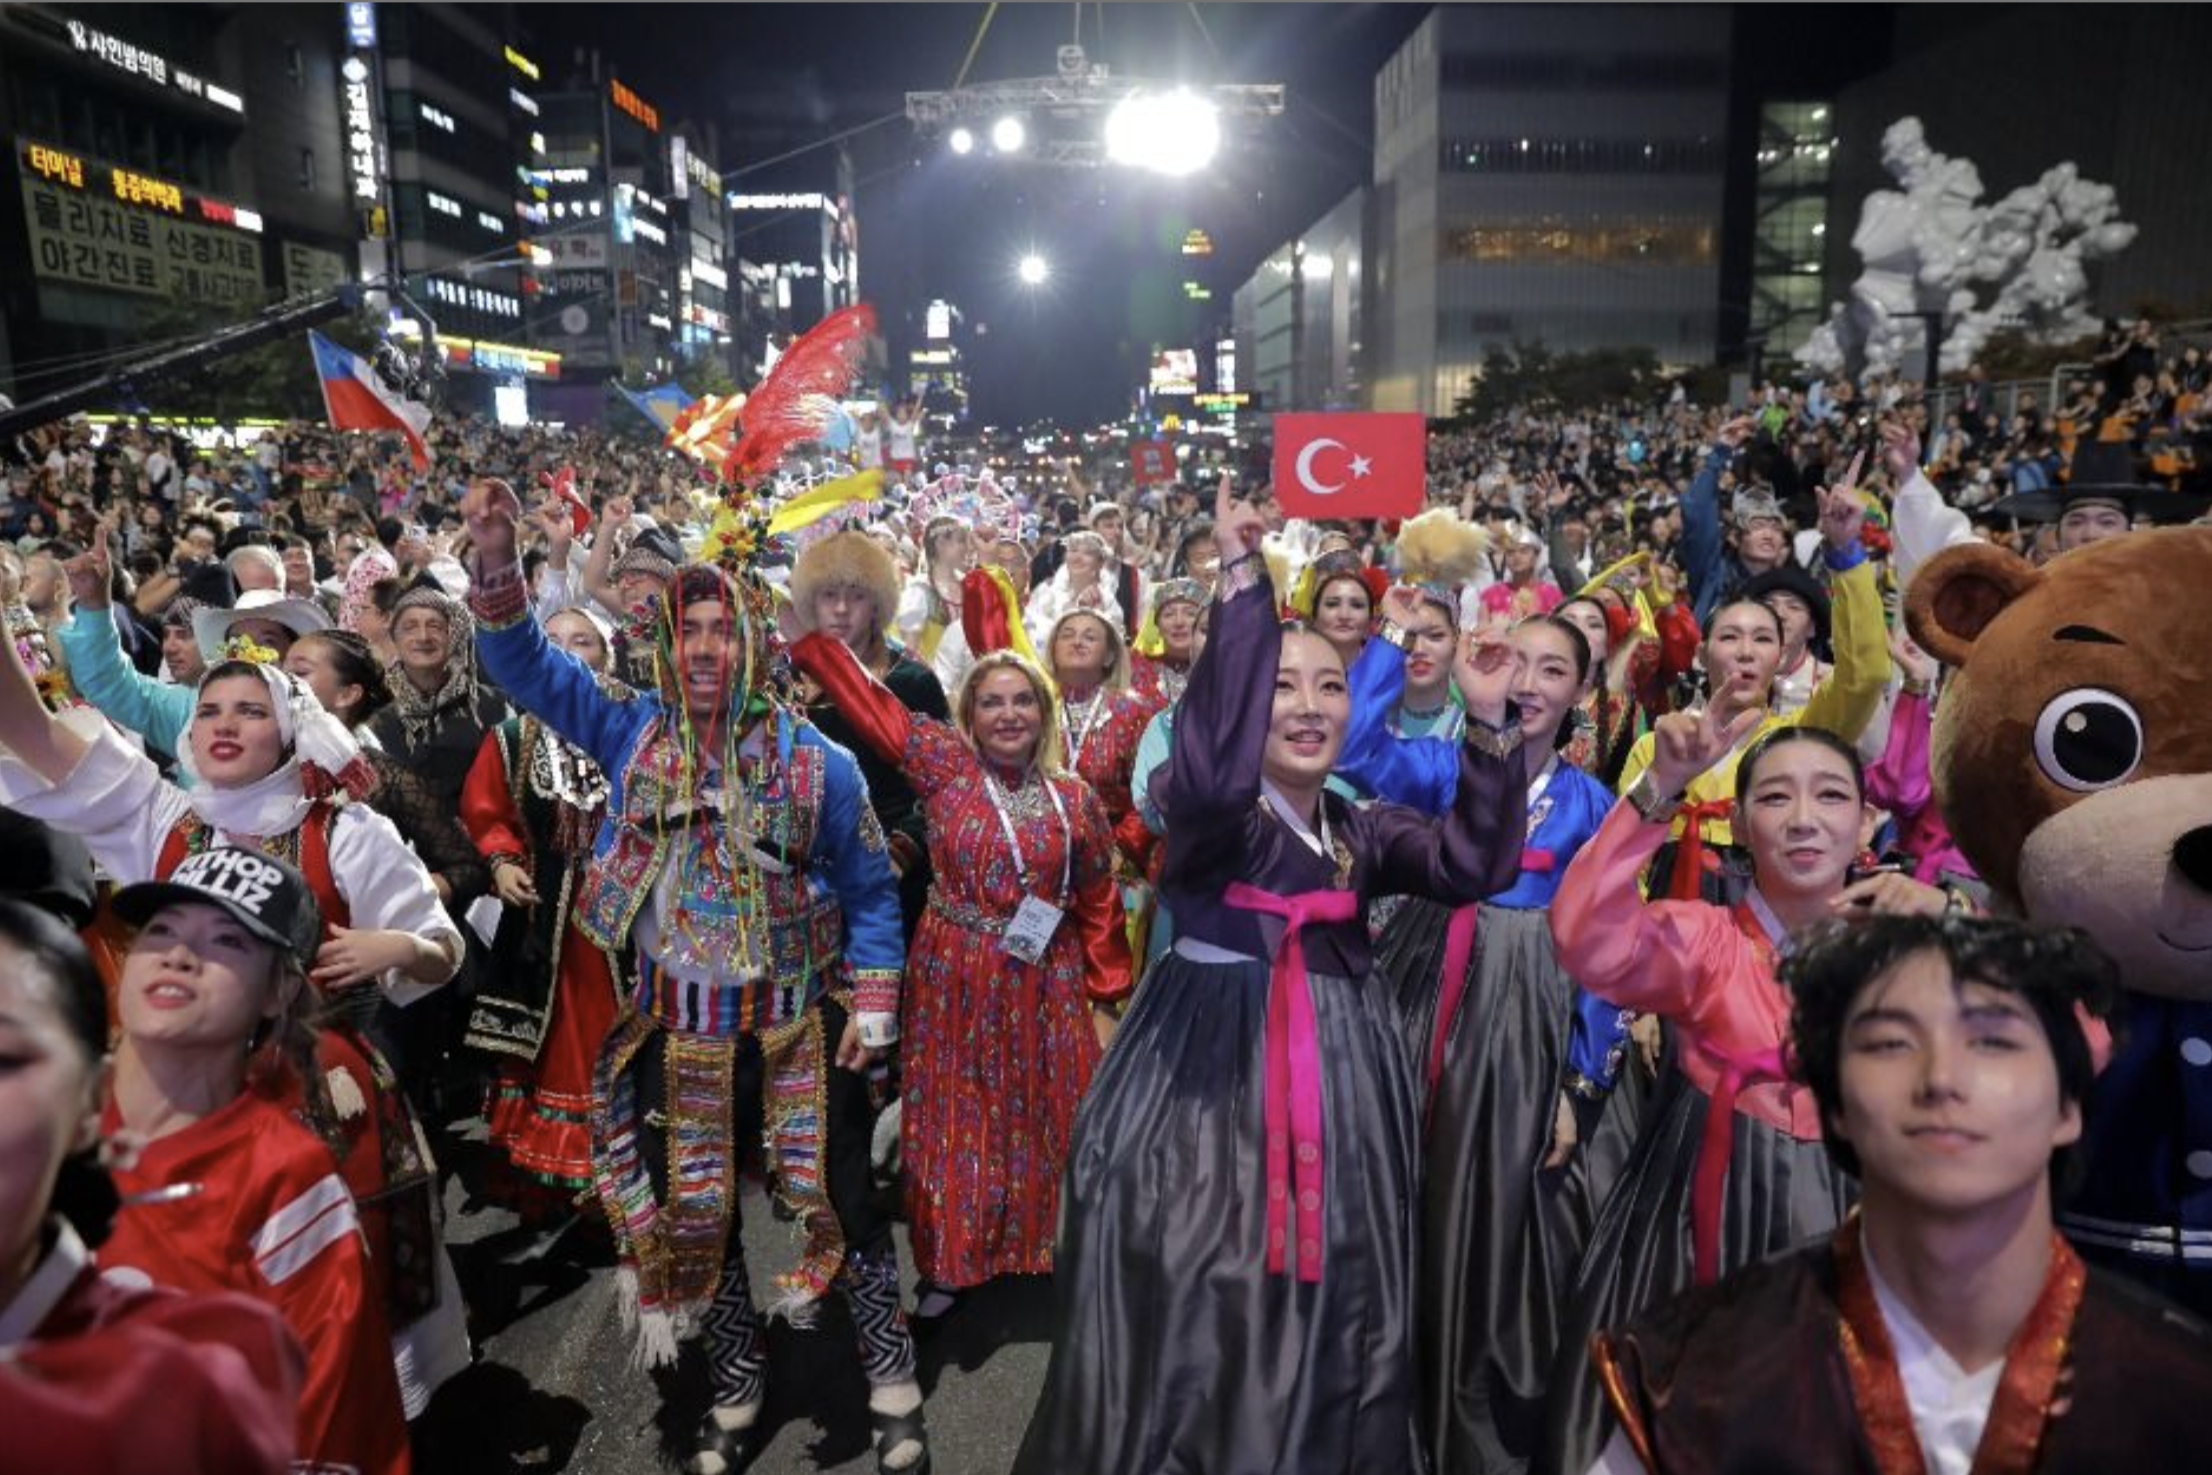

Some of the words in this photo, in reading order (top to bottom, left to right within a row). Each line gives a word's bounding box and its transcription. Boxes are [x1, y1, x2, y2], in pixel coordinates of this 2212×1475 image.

[30, 145, 83, 188] 터미널
[35, 192, 152, 249] 물리치료
[167, 228, 256, 270] 신경치료
[41, 238, 160, 288] 야간진료
